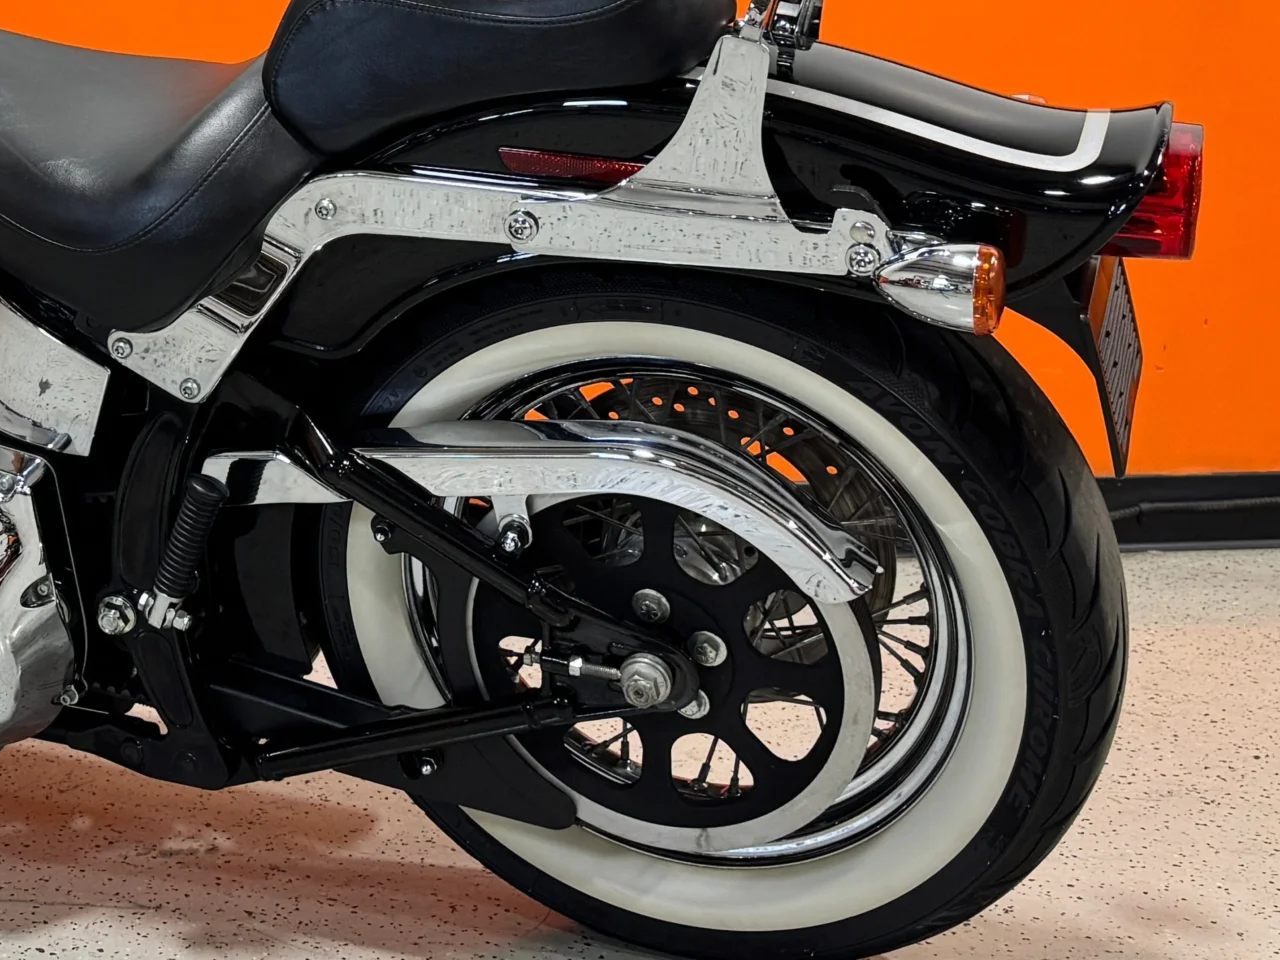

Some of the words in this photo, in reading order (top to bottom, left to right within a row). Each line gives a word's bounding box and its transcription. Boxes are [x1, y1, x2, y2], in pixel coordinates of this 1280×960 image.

[845, 381, 964, 465] AVON
[960, 480, 1045, 618] COBRA
[1007, 641, 1054, 817] CHROME
